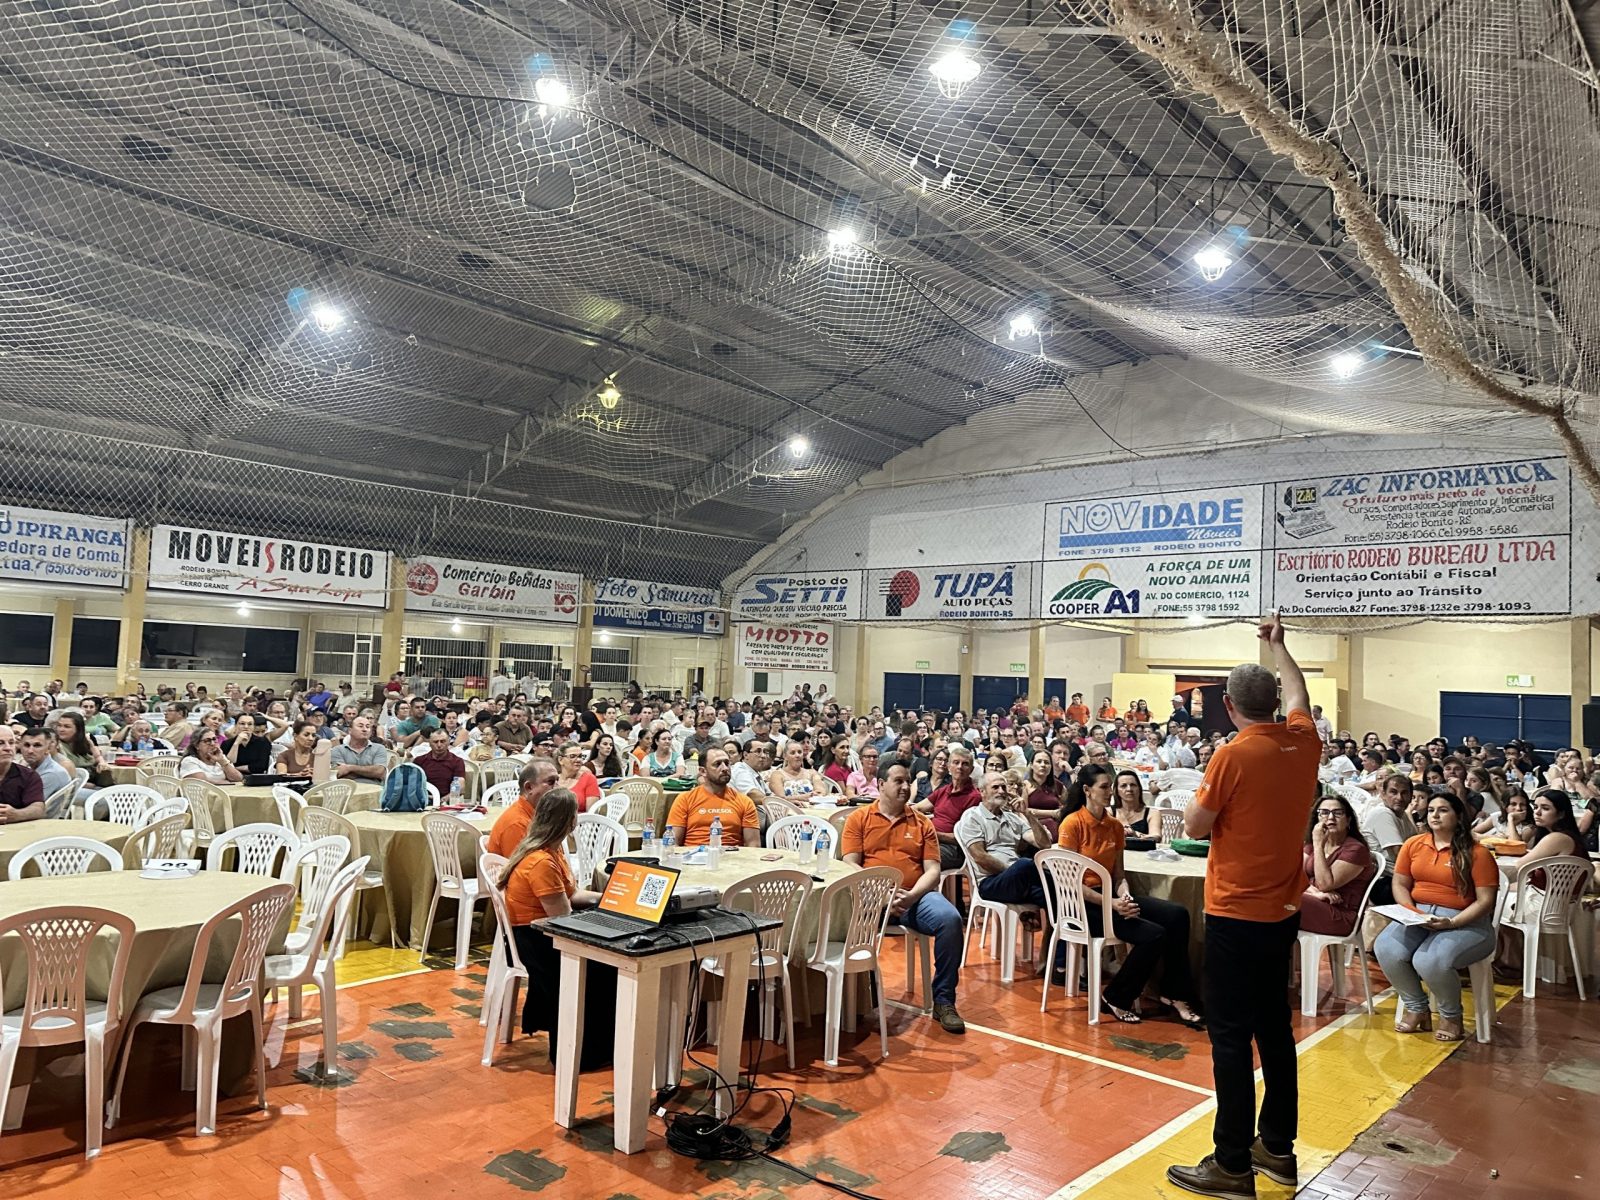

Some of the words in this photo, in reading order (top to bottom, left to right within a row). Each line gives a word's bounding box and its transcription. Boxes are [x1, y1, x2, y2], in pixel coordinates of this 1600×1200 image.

[1321, 476, 1370, 497] ZAC
[1409, 490, 1434, 500] mais
[1471, 487, 1486, 497] de
[1295, 488, 1316, 503] ZAC
[1060, 498, 1243, 535] NOVIDADE
[1386, 518, 1420, 529] Rodeio
[16, 520, 125, 547] IPIRANGA
[52, 544, 71, 559] de
[76, 546, 121, 563] Comb.
[168, 529, 275, 574] MOVEIS
[280, 543, 373, 579] RODEIO
[1058, 549, 1085, 557] FONE
[1090, 547, 1115, 555] 3798
[1153, 543, 1195, 551] RODEIO
[1199, 540, 1242, 549] BONITO
[1277, 550, 1345, 572] Escritório
[1348, 547, 1401, 569] RODEIO
[1407, 543, 1489, 566] BUREAU
[1498, 540, 1557, 563] LTDA
[1146, 562, 1155, 573] A
[1159, 561, 1201, 573] FORÇA
[1206, 560, 1225, 570] DE
[1228, 558, 1252, 569] UM
[442, 564, 501, 584] Comércio
[508, 570, 553, 590] Bebidas
[788, 579, 826, 587] Posto
[830, 577, 848, 585] do
[934, 564, 1017, 598] TUPÃ
[1149, 576, 1186, 586] NOVO
[1188, 571, 1251, 585] AMANHÃ
[1296, 571, 1367, 583] Orientação
[1370, 569, 1427, 581] Contábil
[1433, 571, 1442, 579] e
[1448, 566, 1497, 578] Fiscal
[203, 582, 230, 590] GRANDE
[458, 582, 517, 601] Garbin
[741, 577, 848, 605] SETTI
[1305, 588, 1353, 600] Serviço
[1356, 587, 1392, 602] junto
[1396, 588, 1413, 597] ao
[943, 598, 972, 607] AUTO
[974, 597, 1013, 609] PEÇAS
[1050, 603, 1100, 615] COOPER
[1103, 589, 1140, 614] A1
[1145, 592, 1158, 601] AV.
[1160, 592, 1173, 600] DO
[1228, 590, 1250, 599] 1124
[603, 606, 649, 620] DOMENICO
[660, 611, 703, 625] LOTERIAS
[822, 604, 848, 612] PRECISA
[939, 610, 968, 618] RODEIO
[1195, 604, 1217, 612] 3798
[1219, 603, 1240, 611] 1592
[1292, 605, 1304, 613] Do
[1349, 604, 1366, 613] 827
[745, 625, 829, 646] MIOTTO
